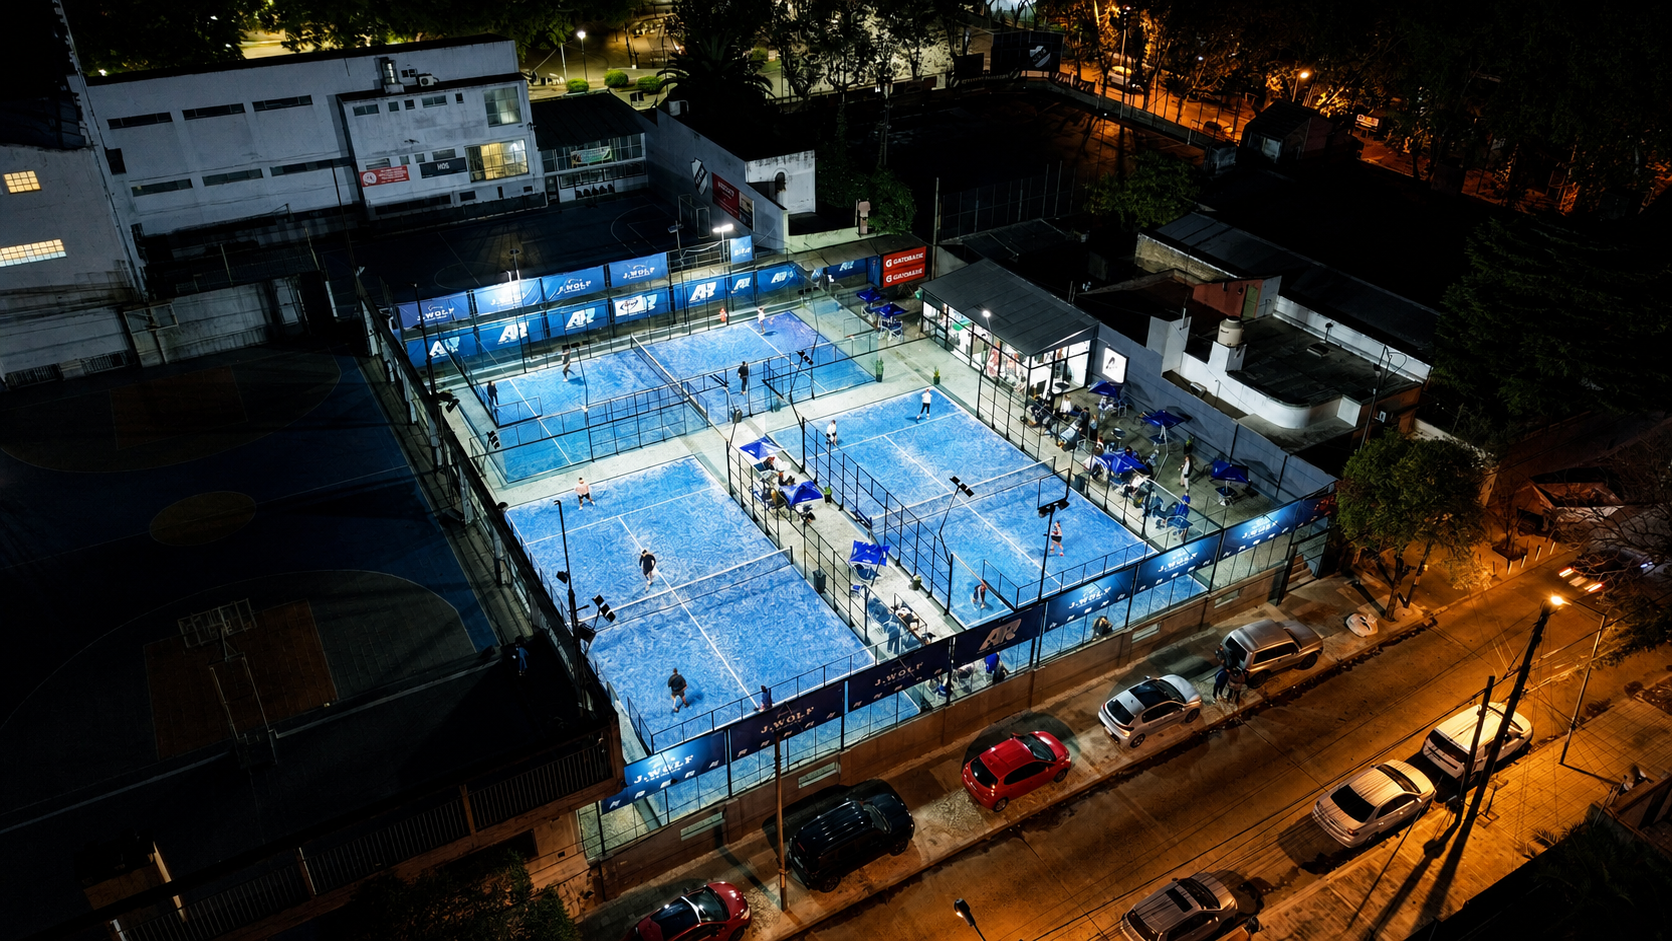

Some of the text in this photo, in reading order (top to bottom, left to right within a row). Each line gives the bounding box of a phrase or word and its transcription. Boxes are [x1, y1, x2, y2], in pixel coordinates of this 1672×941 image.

[893, 252, 924, 265] GATORADE
[875, 661, 924, 687] J.WOLF
[760, 706, 815, 734] J.WOLF
[633, 754, 694, 784] J.WOLF
